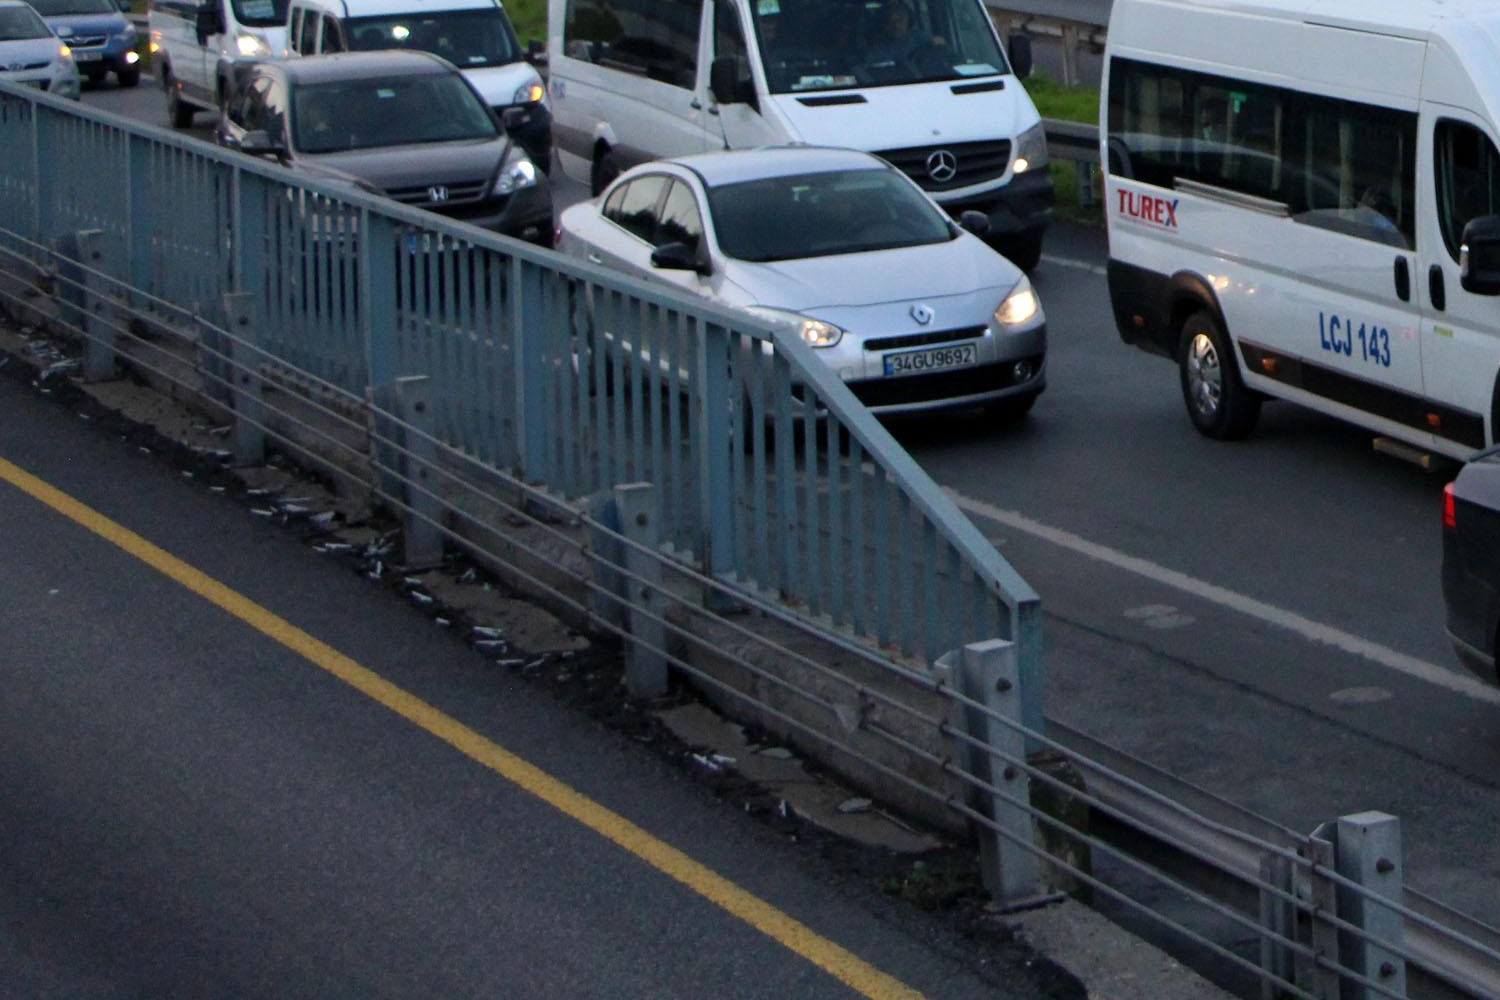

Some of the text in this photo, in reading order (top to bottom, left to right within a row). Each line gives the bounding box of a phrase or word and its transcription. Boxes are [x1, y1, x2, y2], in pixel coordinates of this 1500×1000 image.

[1118, 188, 1179, 228] TUREX
[1319, 312, 1391, 368] LCJ 143
